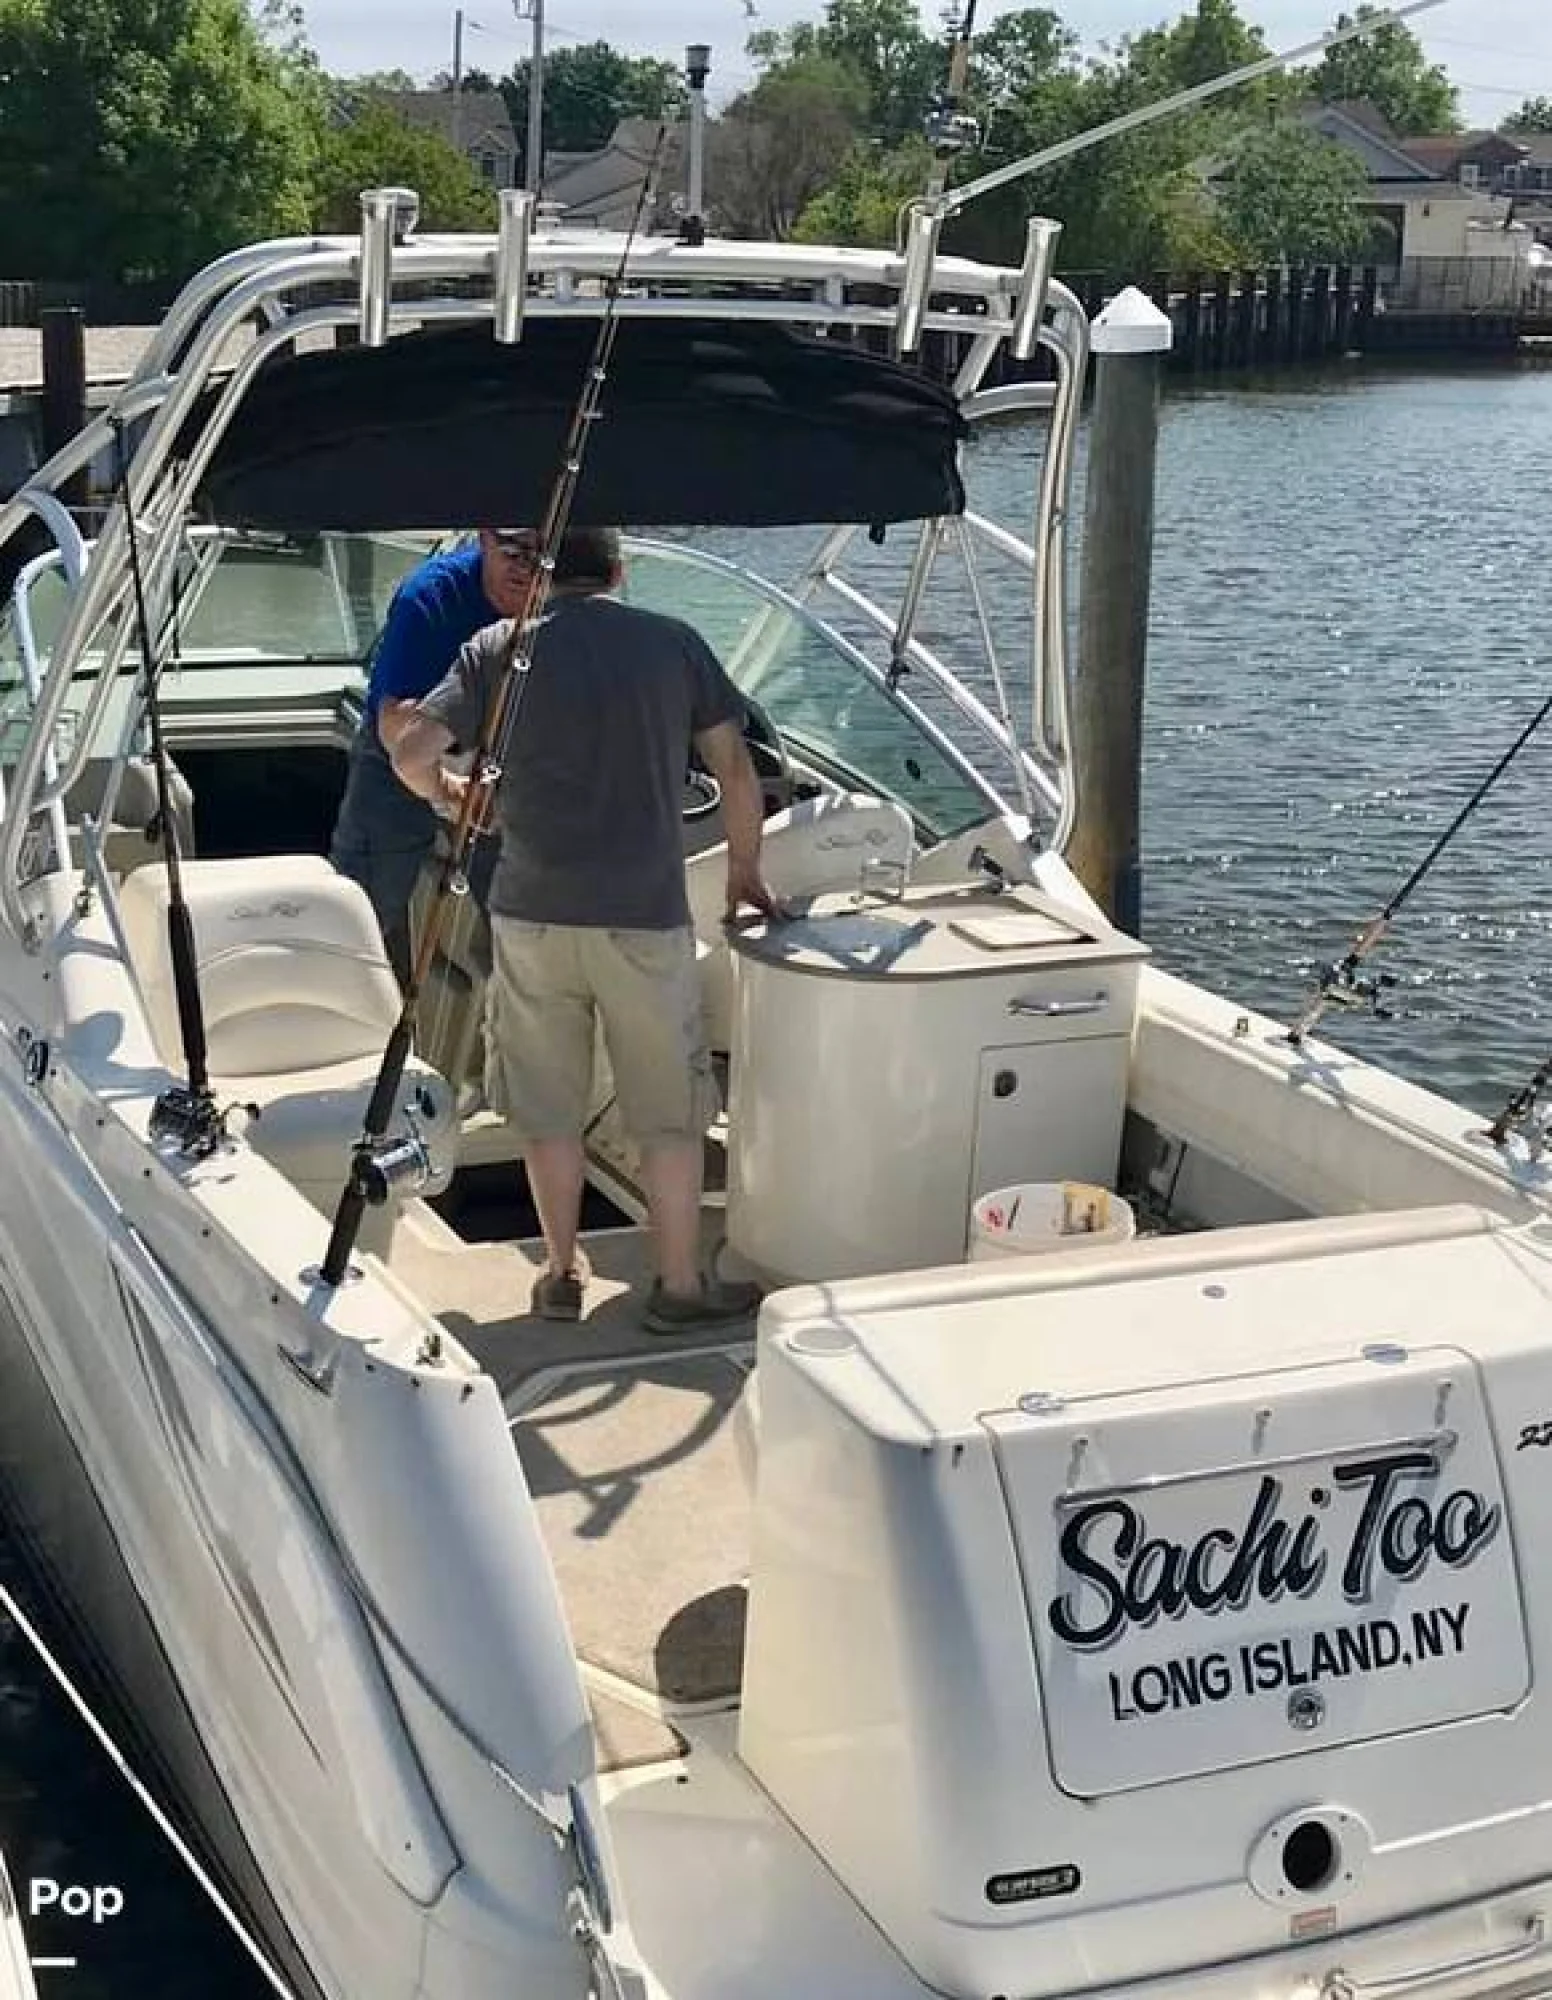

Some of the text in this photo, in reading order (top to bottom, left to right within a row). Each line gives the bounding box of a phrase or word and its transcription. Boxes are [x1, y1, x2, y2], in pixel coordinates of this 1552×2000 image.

[1049, 1452, 1500, 1652] Sachi Too
[1108, 1652, 1231, 1721] LONG
